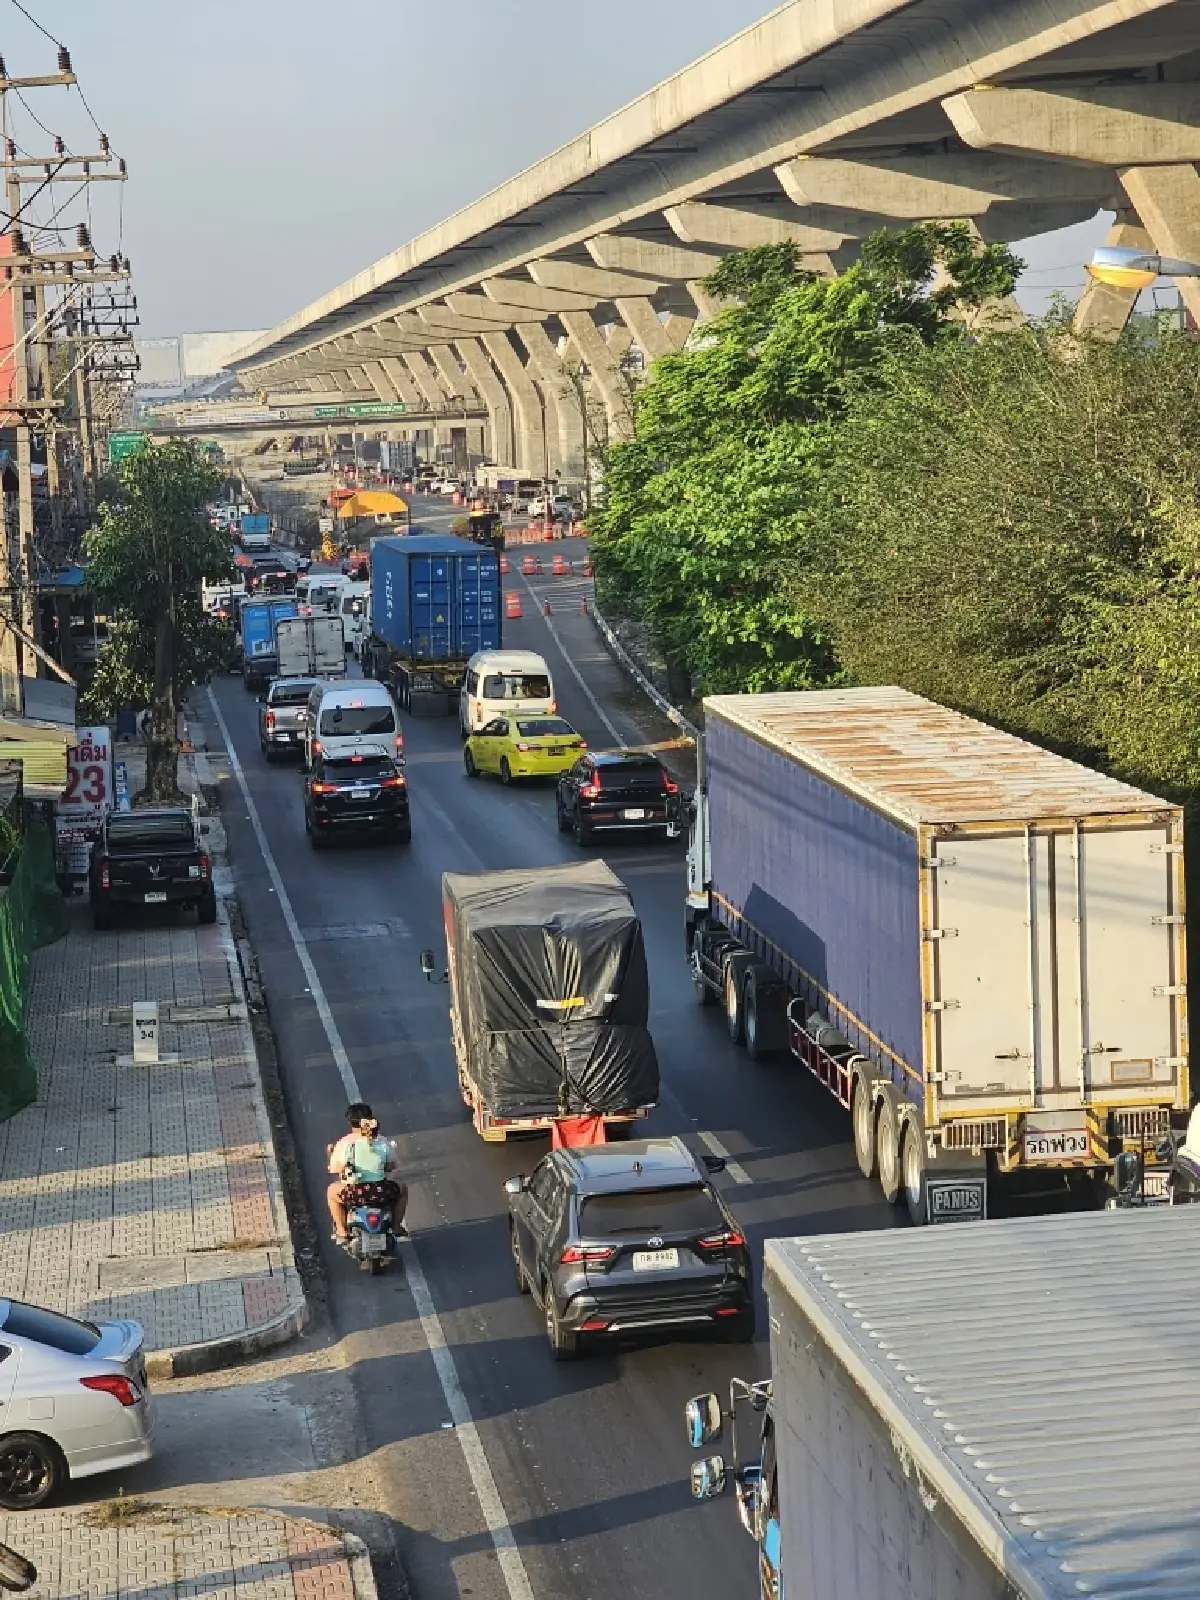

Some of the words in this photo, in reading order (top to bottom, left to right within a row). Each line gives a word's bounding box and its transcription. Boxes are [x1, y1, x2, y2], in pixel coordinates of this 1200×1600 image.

[61, 765, 106, 803] 23
[141, 1030, 154, 1040] 34
[1026, 1133, 1087, 1154] รถพ่วง
[935, 1190, 979, 1210] PANUS
